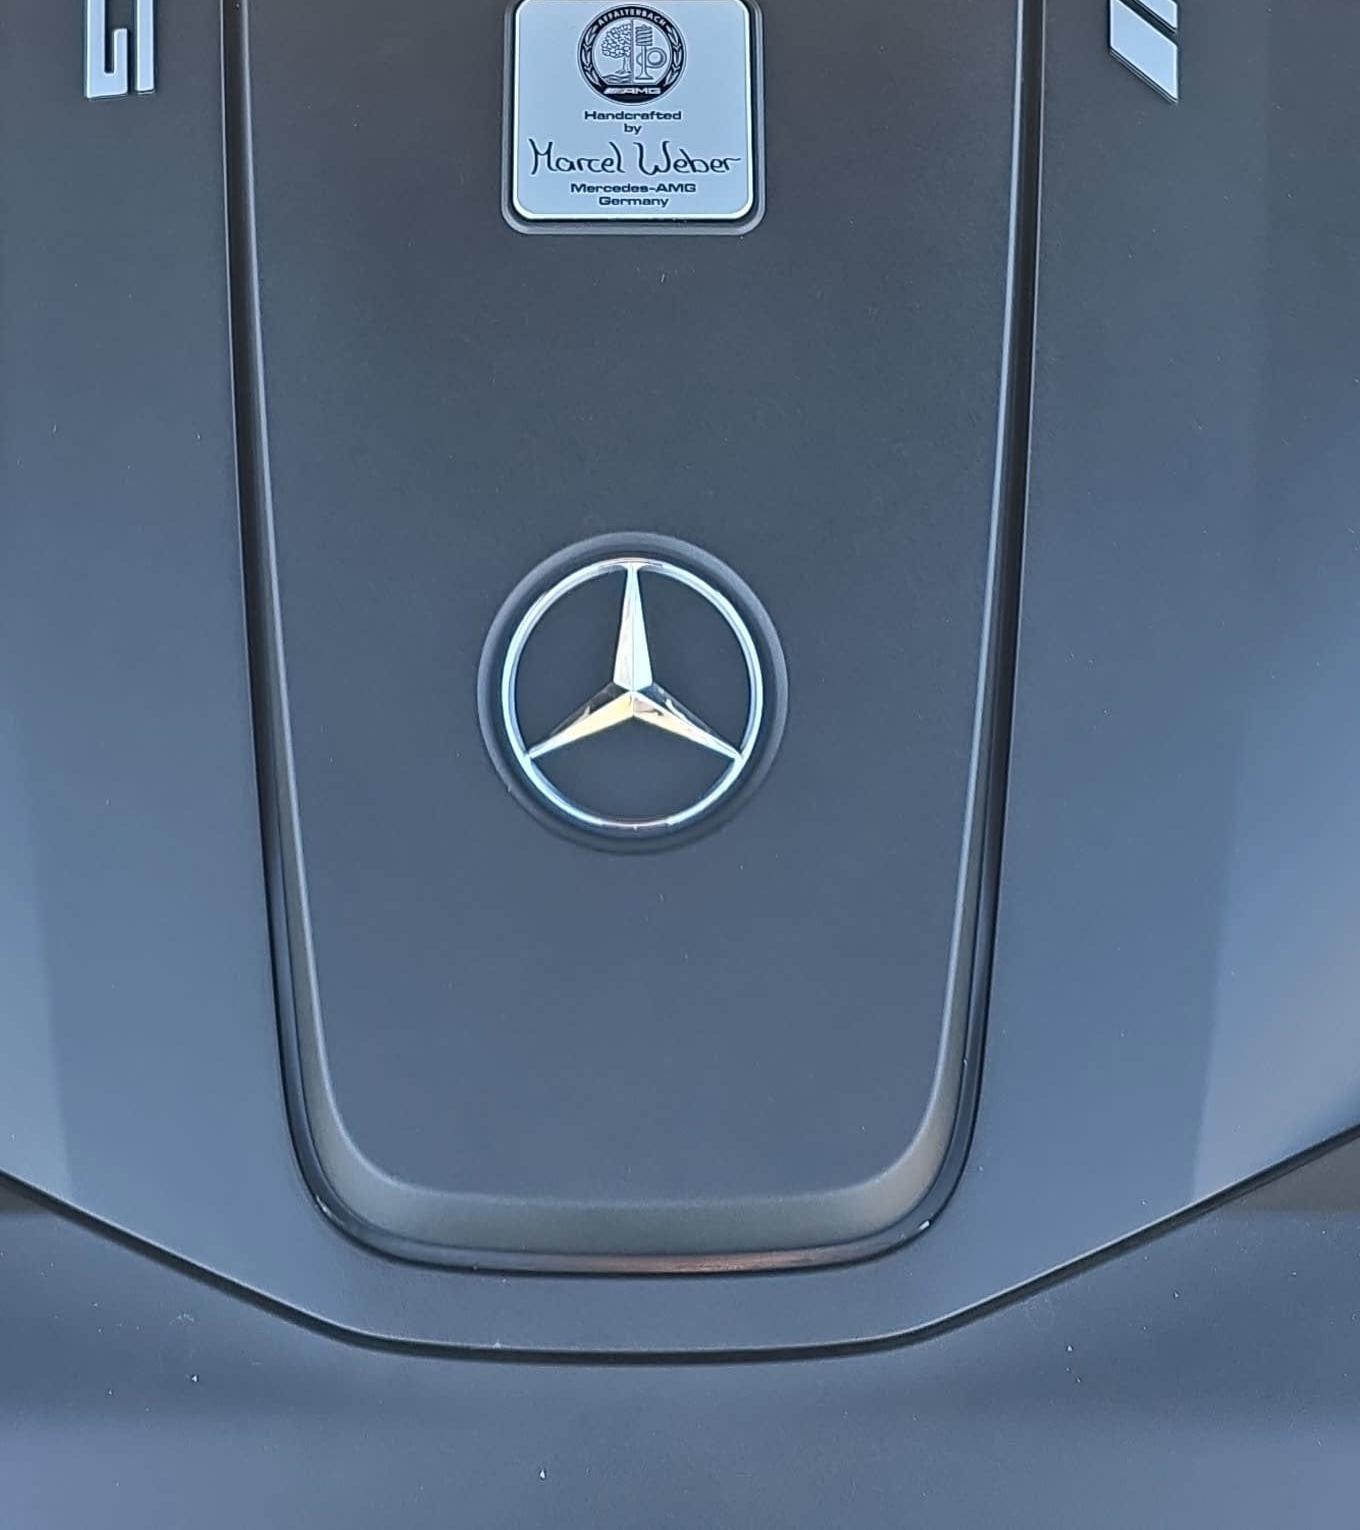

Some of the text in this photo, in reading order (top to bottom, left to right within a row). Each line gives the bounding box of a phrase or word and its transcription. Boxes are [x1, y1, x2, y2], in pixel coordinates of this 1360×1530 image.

[597, 8, 667, 27] AFFALTERBACH
[584, 110, 682, 121] Handcrafted
[623, 122, 642, 135] by
[528, 138, 742, 177] Marcel Weber
[570, 182, 697, 194] Mercedes-AMG
[598, 196, 670, 209] Germany
